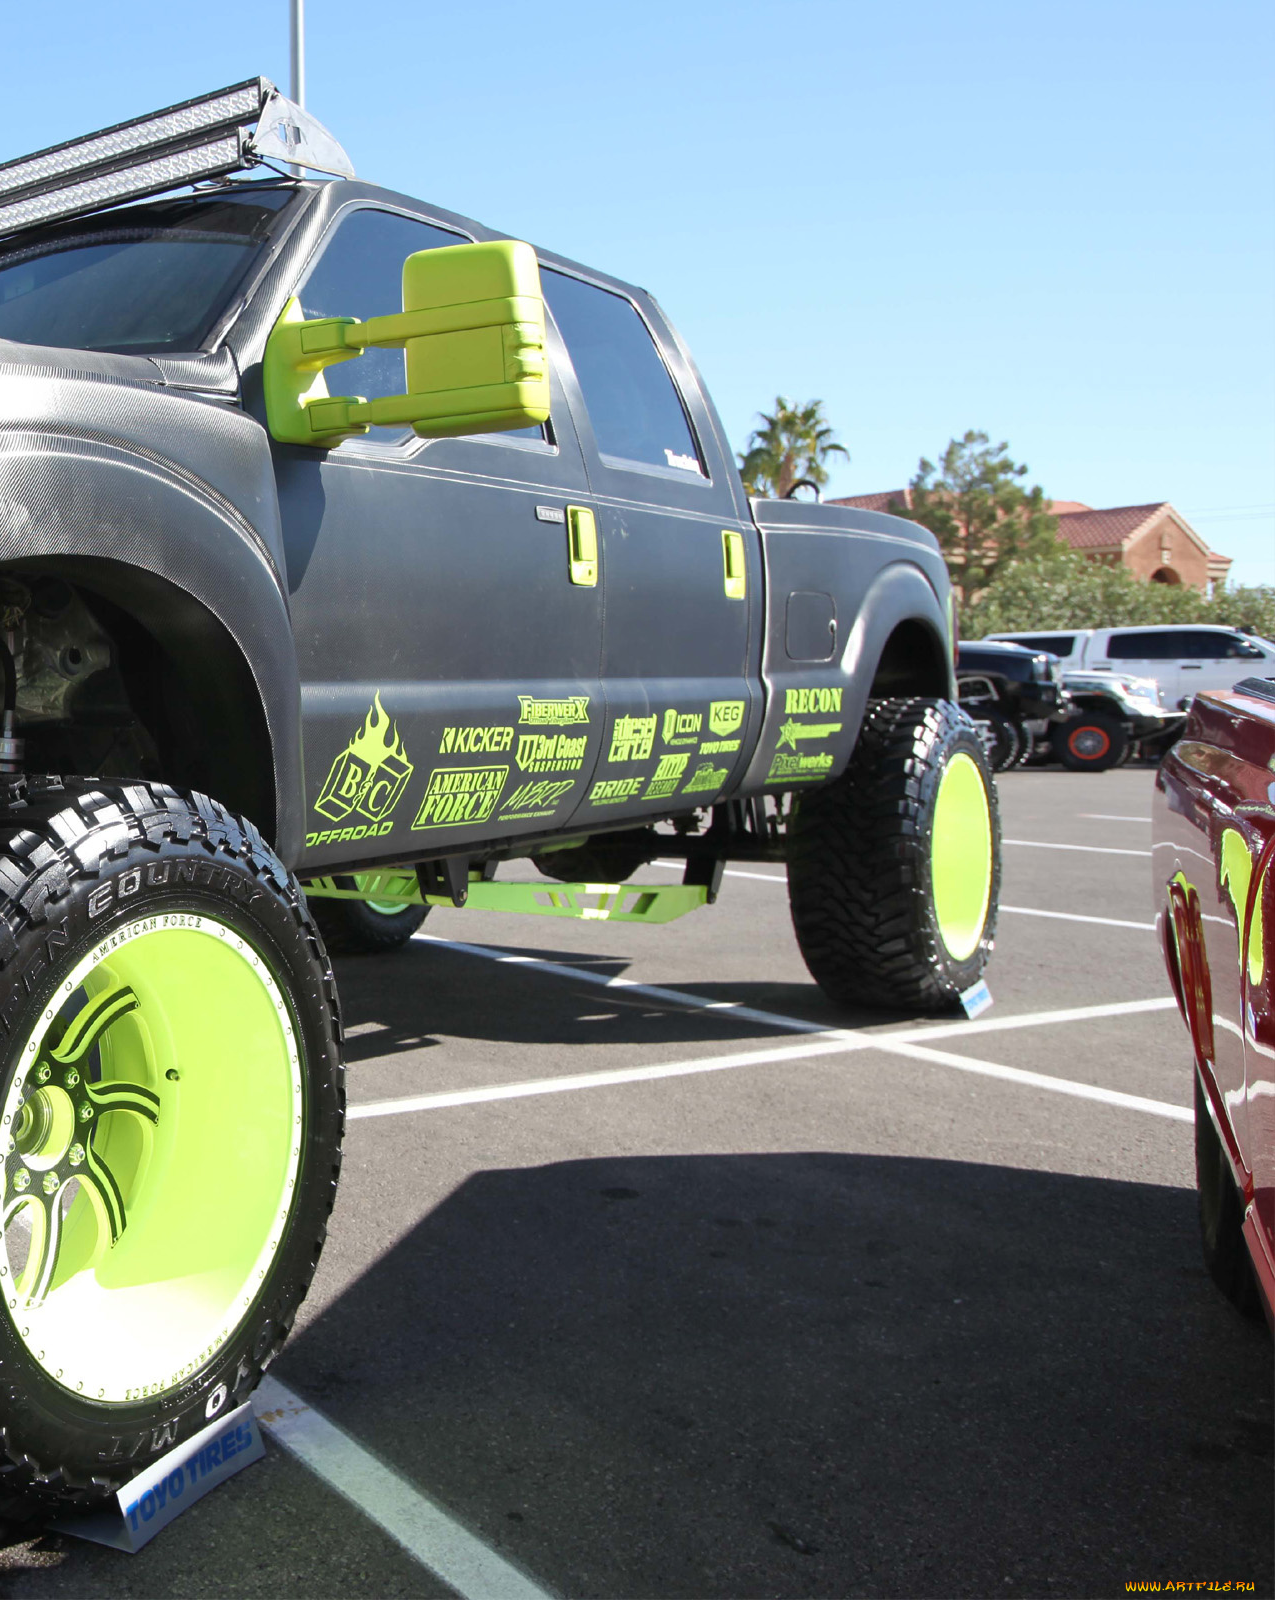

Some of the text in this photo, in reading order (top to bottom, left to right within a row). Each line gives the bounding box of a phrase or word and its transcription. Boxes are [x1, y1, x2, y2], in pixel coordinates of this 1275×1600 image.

[785, 687, 843, 714] RECON
[676, 713, 703, 733] ICON
[713, 706, 740, 722] KEG
[453, 727, 515, 753] KICKER
[536, 734, 587, 760] 3rd Coast
[528, 759, 583, 773] SUSPENSION
[428, 771, 505, 794] AMERICAN
[589, 777, 645, 800] BRIDE
[416, 790, 499, 825] FORCE
[306, 822, 393, 847] OFFROAD
[88, 859, 263, 918] COUNTRY
[92, 915, 202, 963] AMERICAN FORCE
[126, 1327, 229, 1401] AMERICAN FORCE
[126, 1421, 252, 1532] TOYO TIRES
